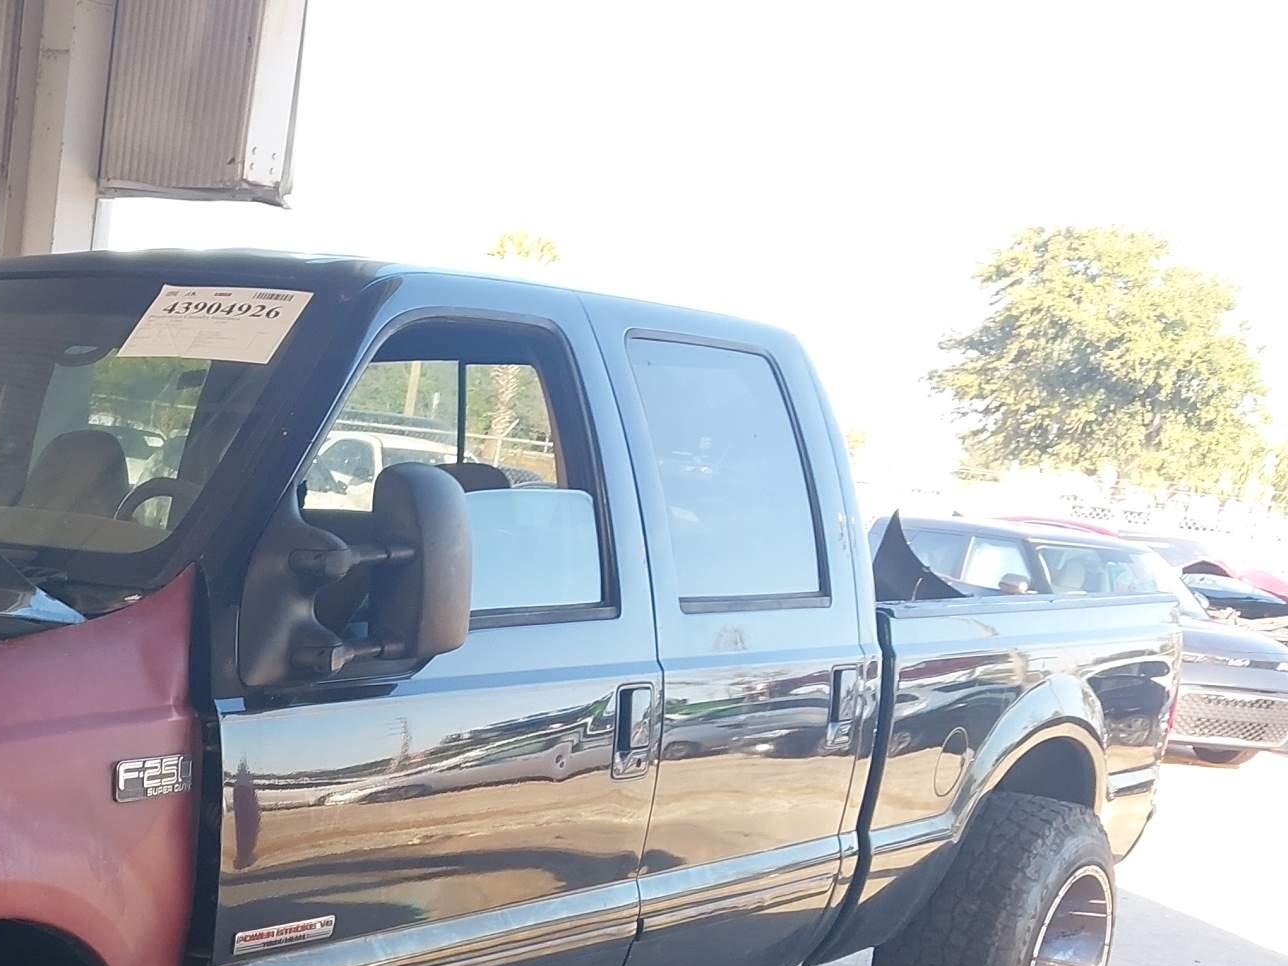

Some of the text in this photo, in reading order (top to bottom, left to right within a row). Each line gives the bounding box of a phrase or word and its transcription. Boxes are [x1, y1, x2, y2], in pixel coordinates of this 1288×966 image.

[162, 301, 283, 318] 43904926
[147, 785, 173, 797] SUPER
[236, 930, 275, 944] POWER
[276, 922, 317, 936] STROKE
